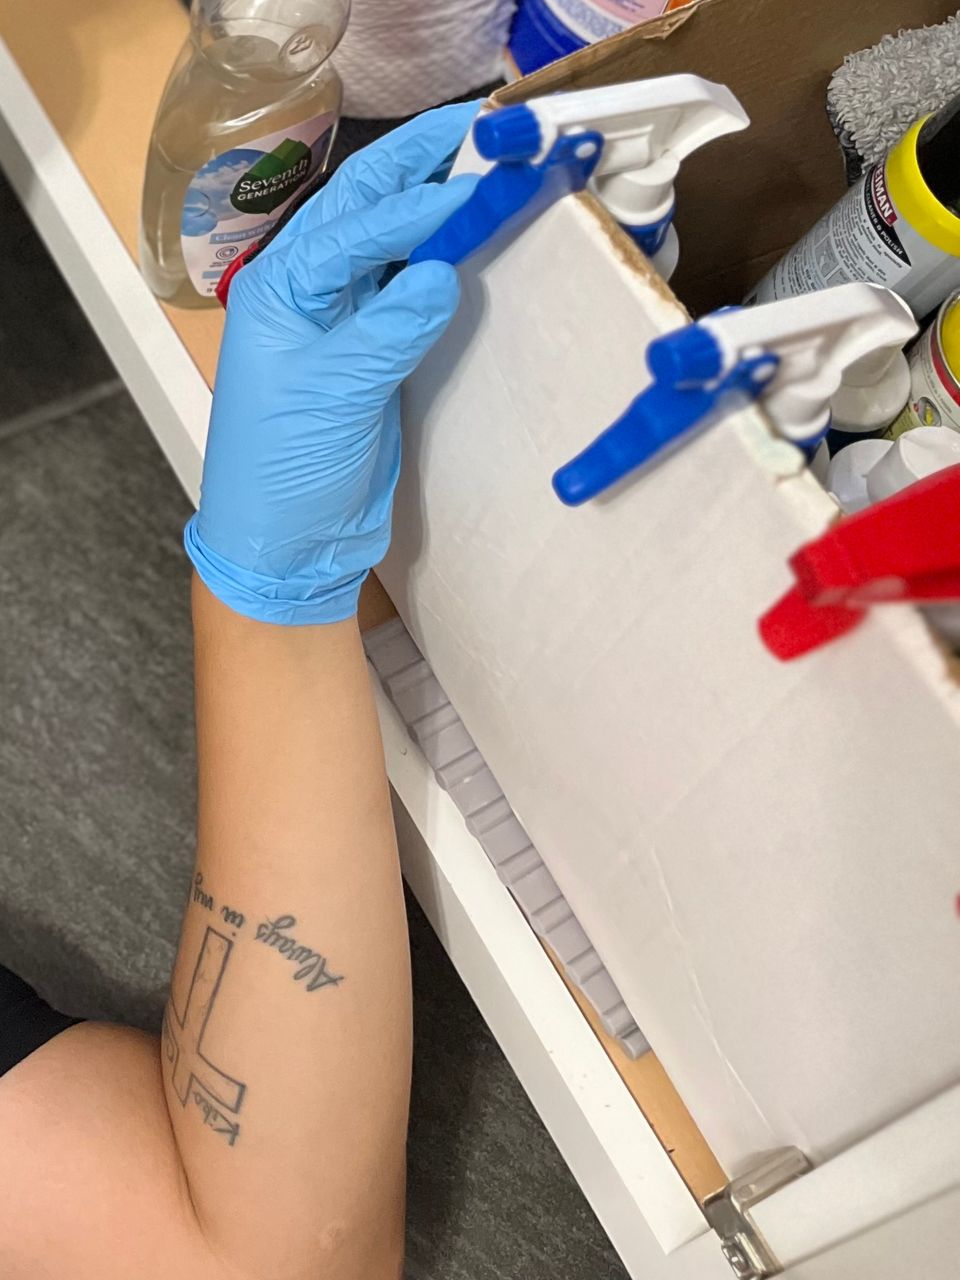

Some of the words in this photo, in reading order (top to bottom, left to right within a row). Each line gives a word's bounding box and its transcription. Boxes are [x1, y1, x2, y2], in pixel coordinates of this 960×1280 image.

[237, 170, 307, 201] GENERATION
[239, 158, 308, 193] Seventh
[880, 230, 903, 255] POLISH
[254, 914, 345, 992] Always
